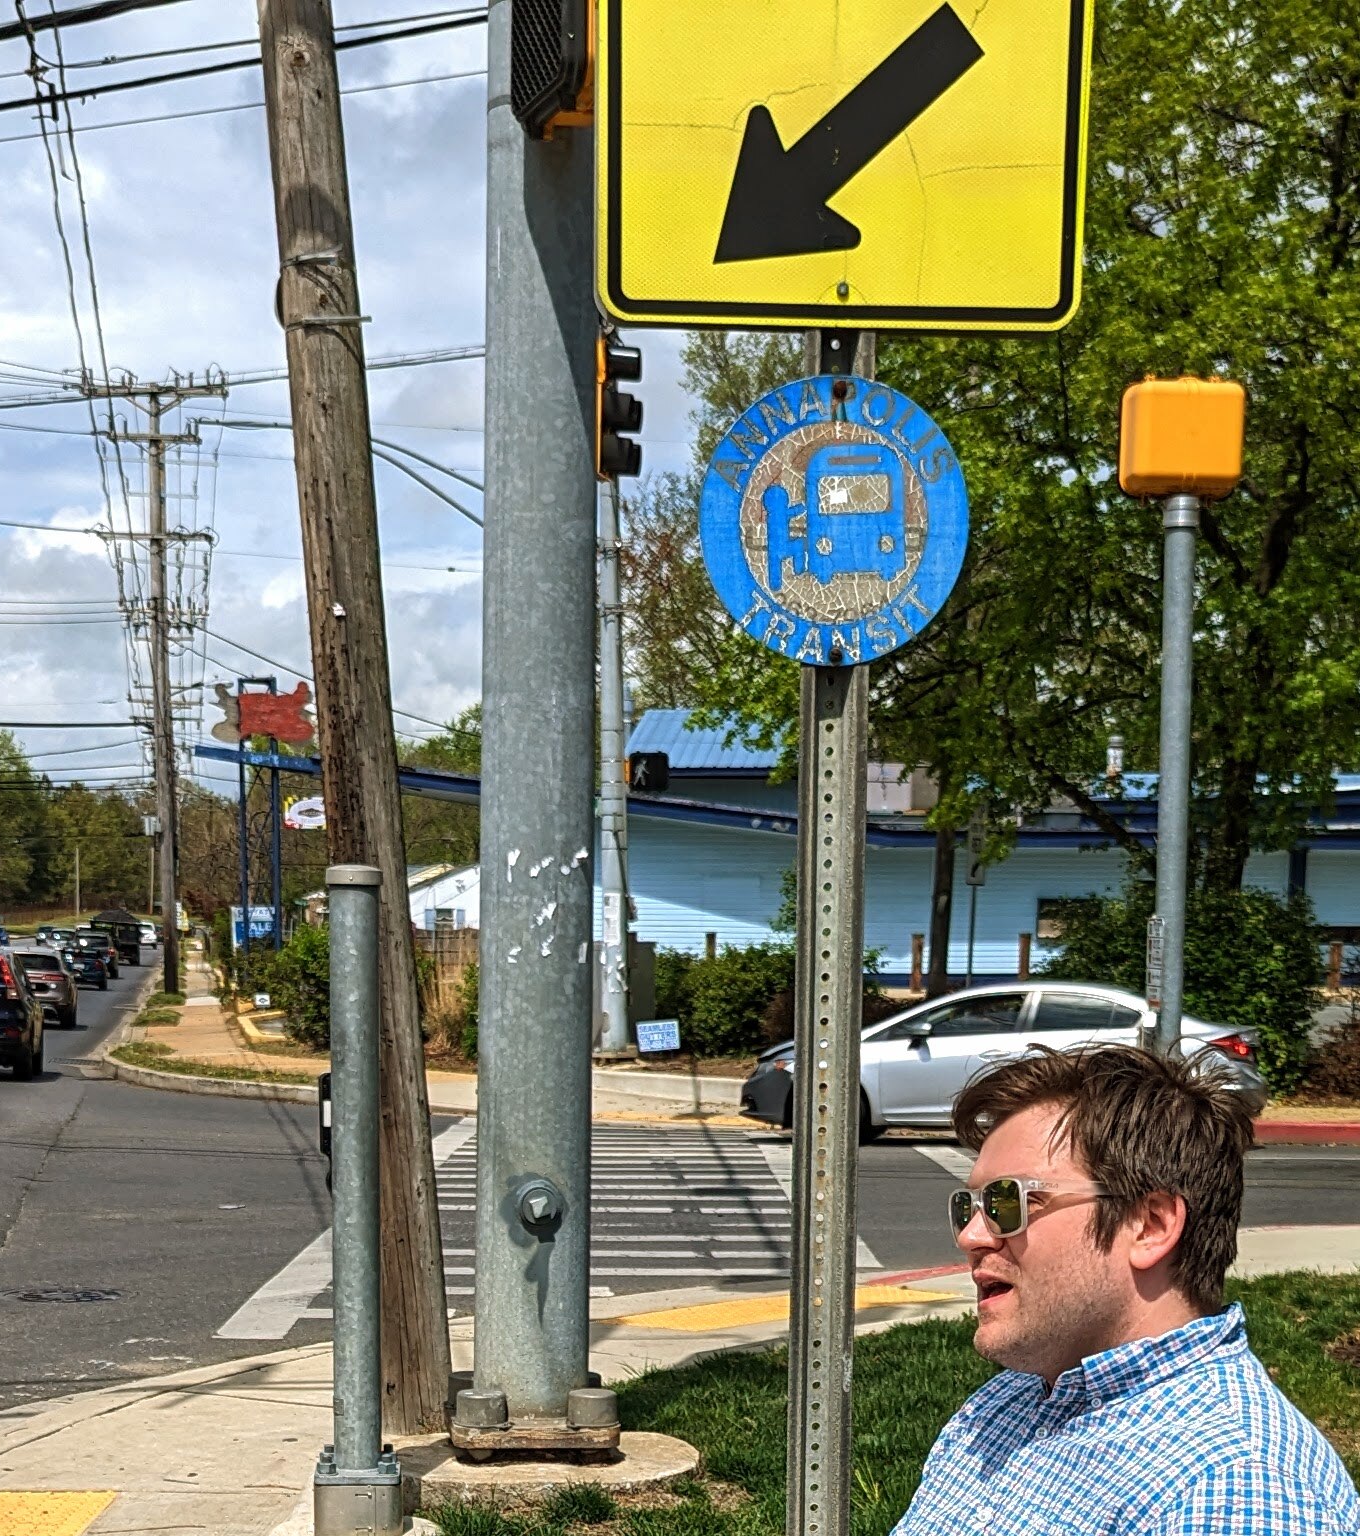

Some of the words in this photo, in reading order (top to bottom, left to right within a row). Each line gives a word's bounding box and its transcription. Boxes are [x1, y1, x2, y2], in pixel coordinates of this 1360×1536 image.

[714, 380, 955, 493] ANNAPOLIS
[741, 583, 934, 663] TRANSIT
[639, 1023, 676, 1033] SEAMLESS
